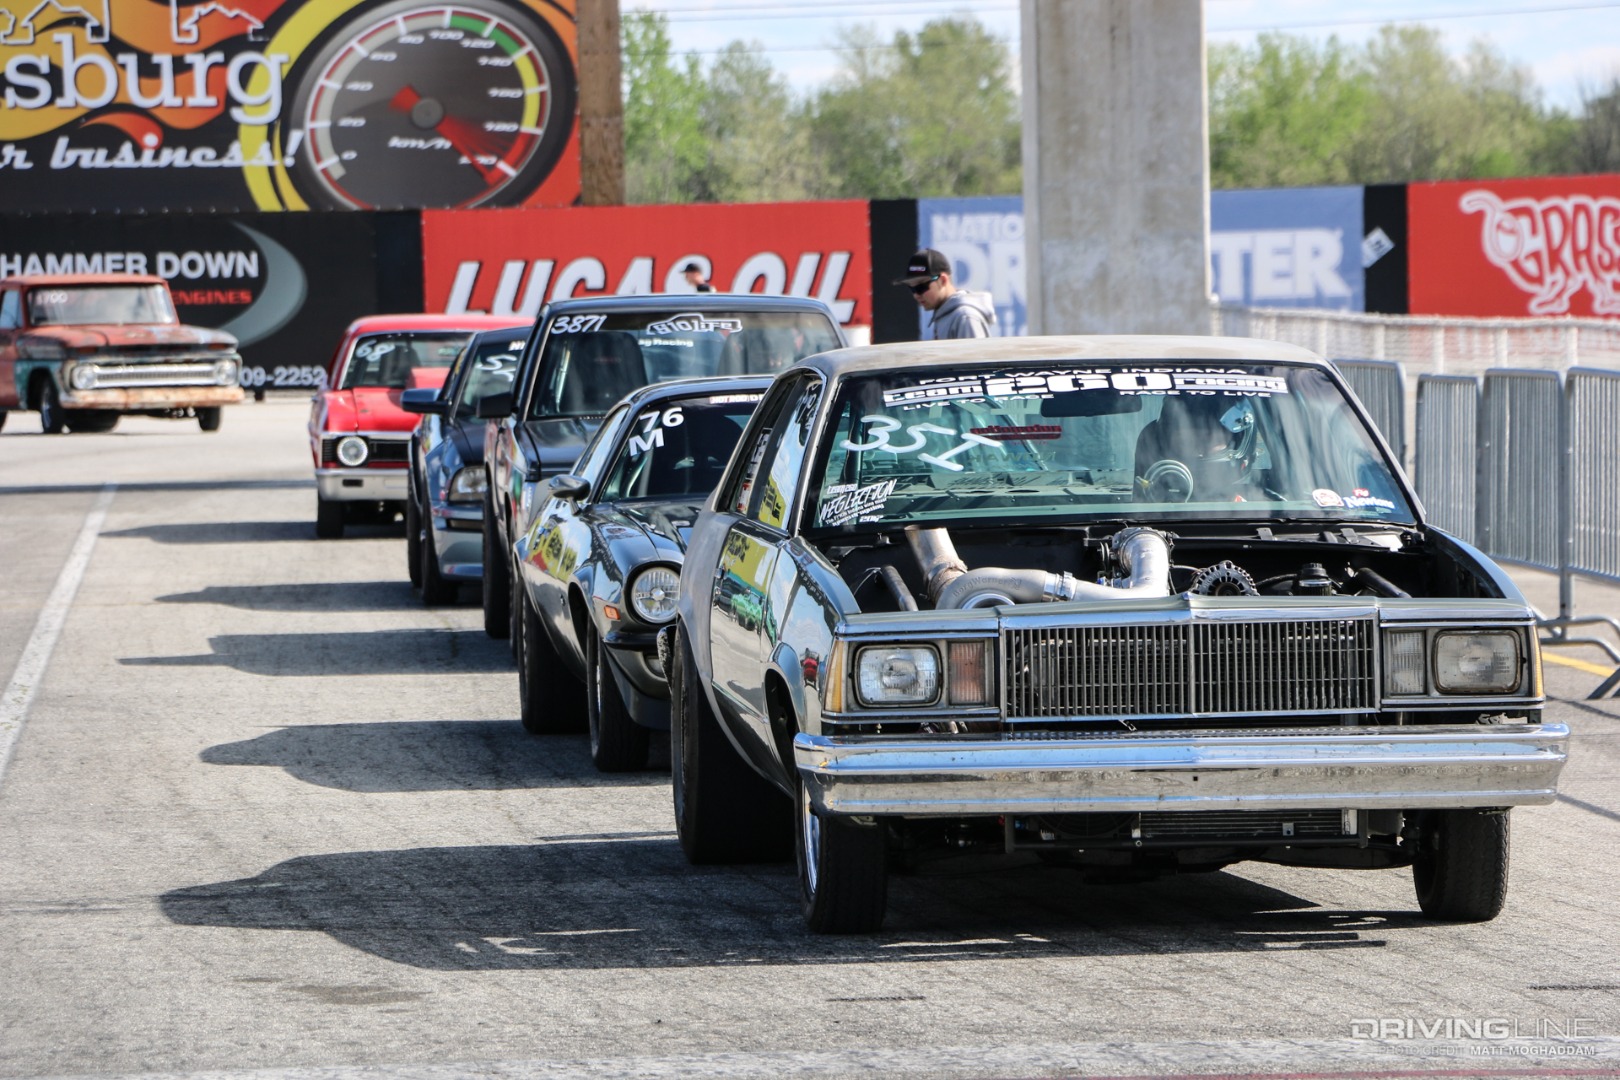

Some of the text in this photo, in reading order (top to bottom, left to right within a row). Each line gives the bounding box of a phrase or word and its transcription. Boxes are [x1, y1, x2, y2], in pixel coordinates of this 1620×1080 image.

[50, 129, 304, 169] business!
[1, 252, 259, 278] HAMMER DOWN
[1211, 229, 1343, 298] TER
[445, 251, 857, 323] LUCAS OIL
[551, 315, 607, 334] 3871
[653, 337, 694, 347] Racing
[241, 366, 326, 387] 09-2252
[919, 374, 995, 385] FORT
[1005, 368, 1112, 378] WAYNE
[884, 384, 983, 405] team
[903, 402, 950, 411] LIVE
[994, 394, 1055, 402] RACE
[639, 407, 684, 434] 76
[628, 428, 665, 456] M
[819, 479, 897, 523] NEGLECTION
